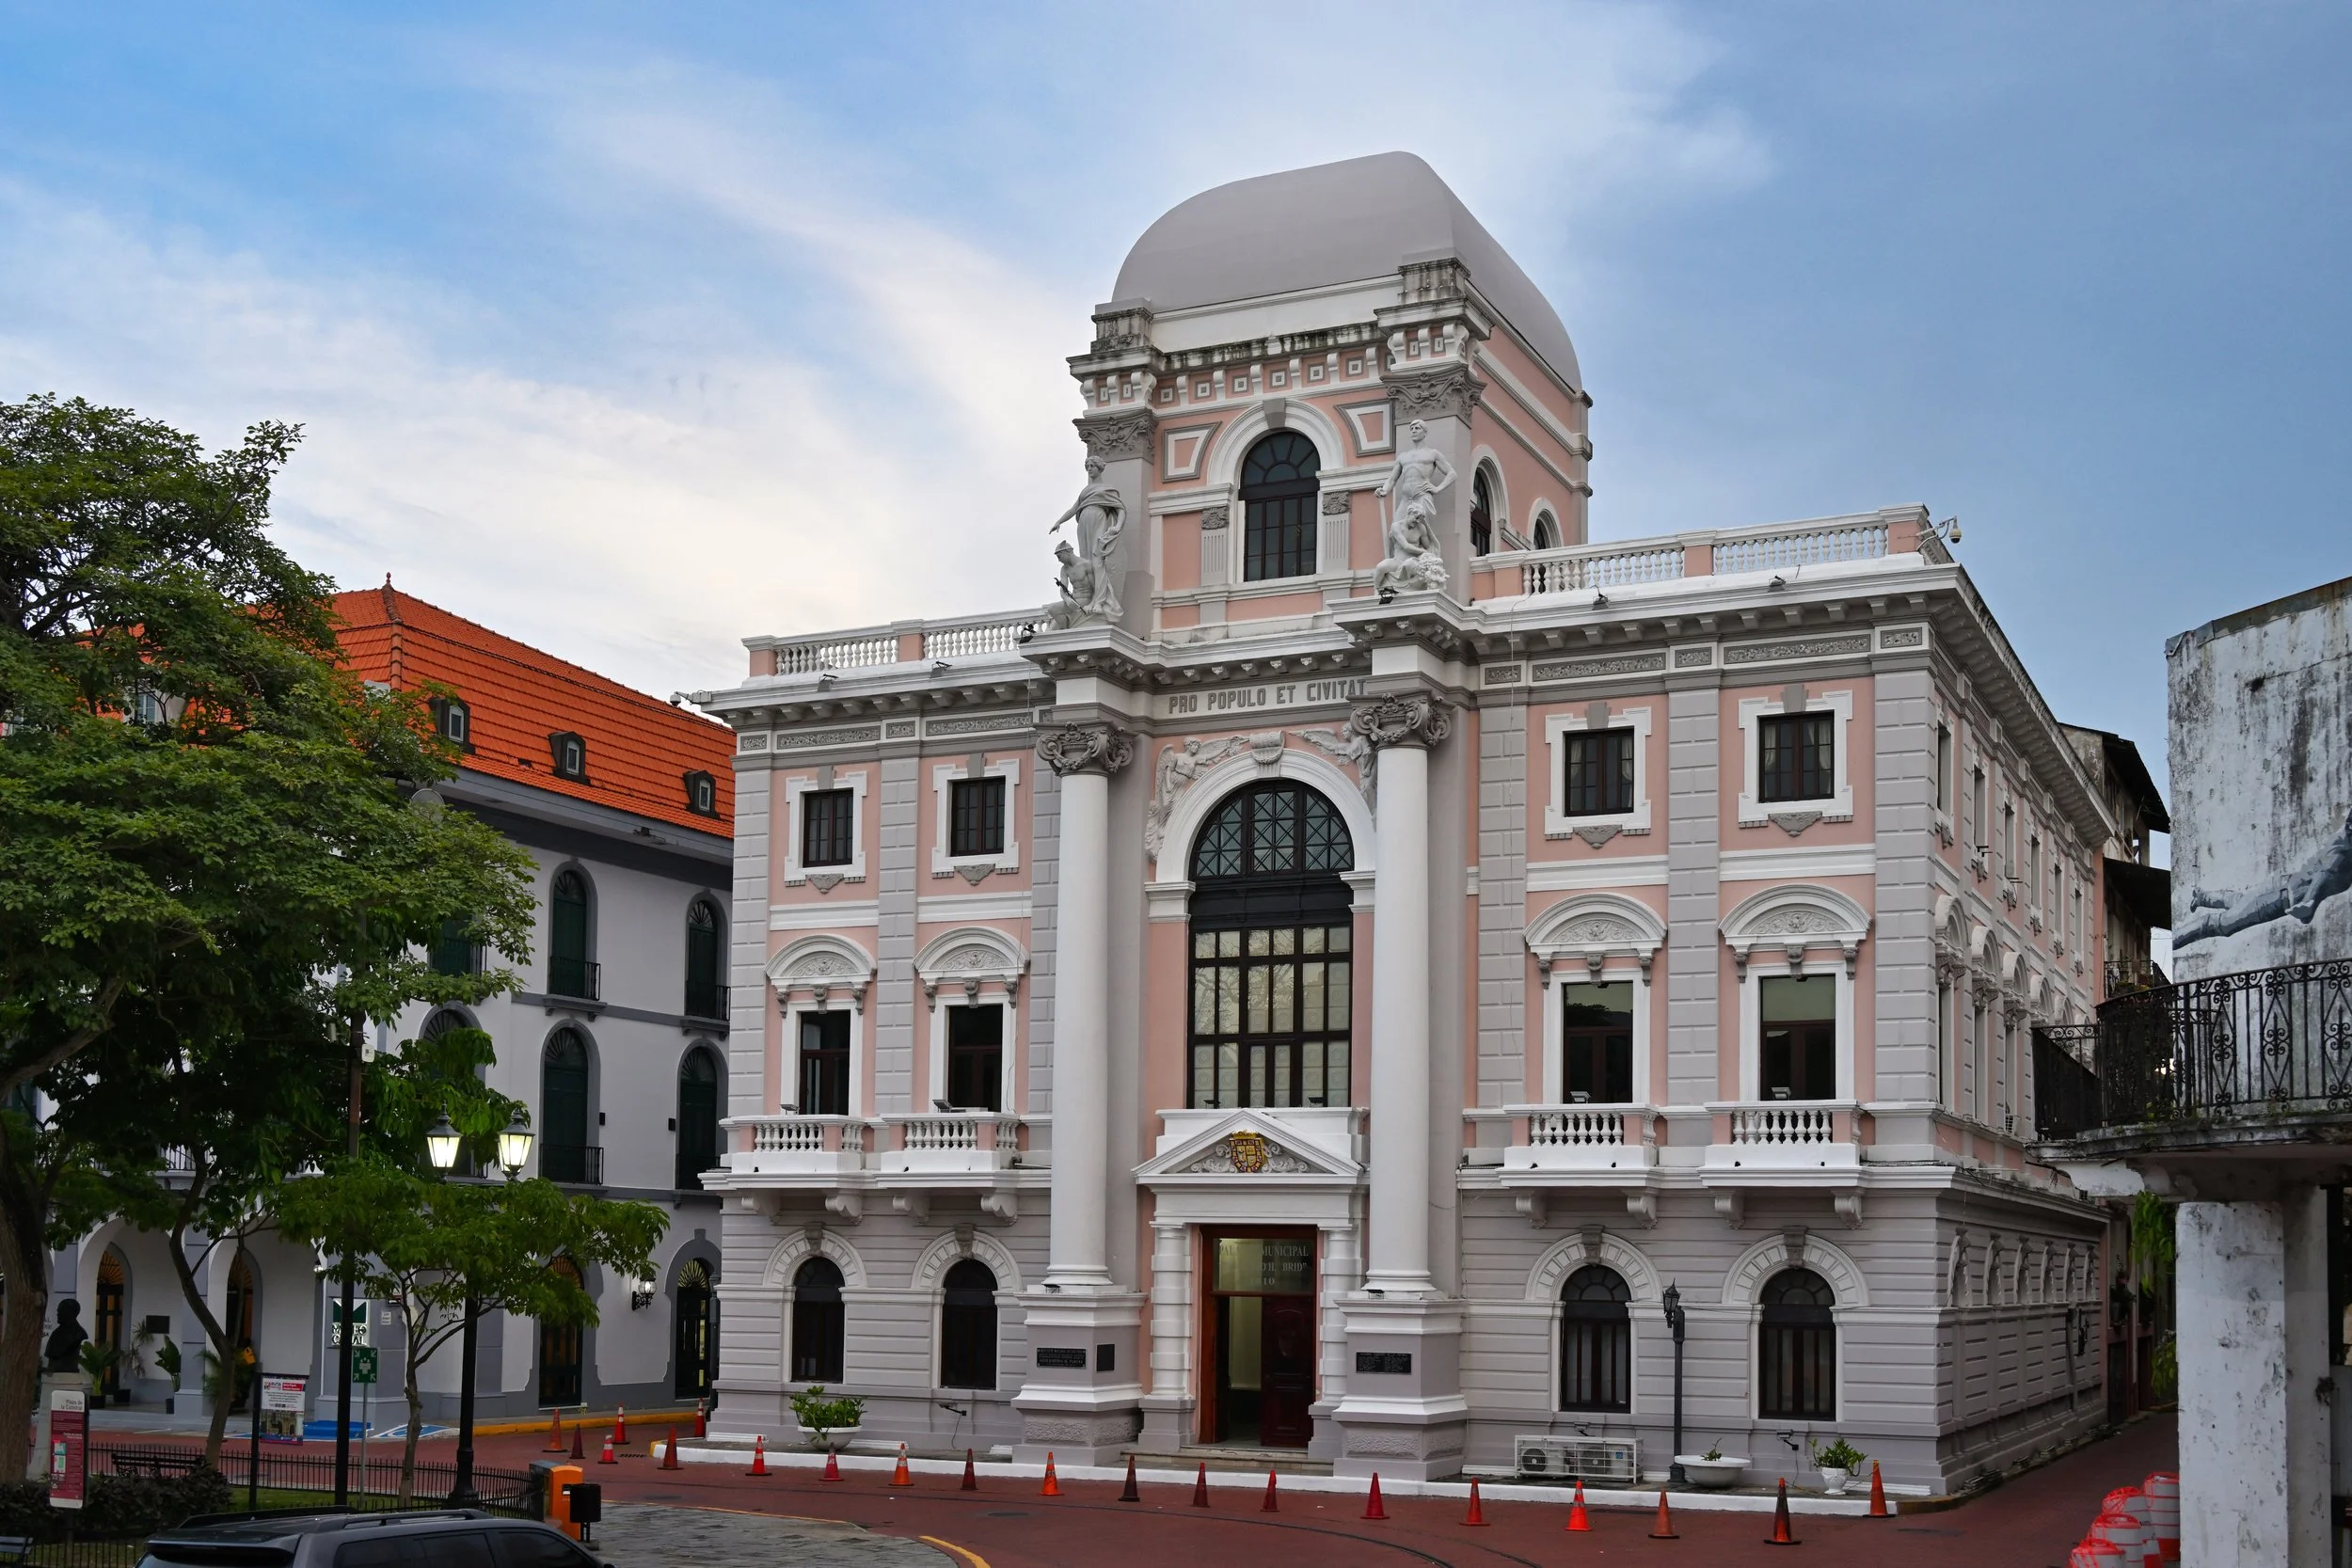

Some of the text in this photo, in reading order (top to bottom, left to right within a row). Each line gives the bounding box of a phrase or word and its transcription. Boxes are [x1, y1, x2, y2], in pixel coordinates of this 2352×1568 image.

[1168, 679, 1366, 714] PRO POPULO ET CIVITAT
[1261, 1245, 1309, 1257] MUNICIPAL
[332, 1323, 367, 1335] MEO
[332, 1334, 367, 1345] CAL
